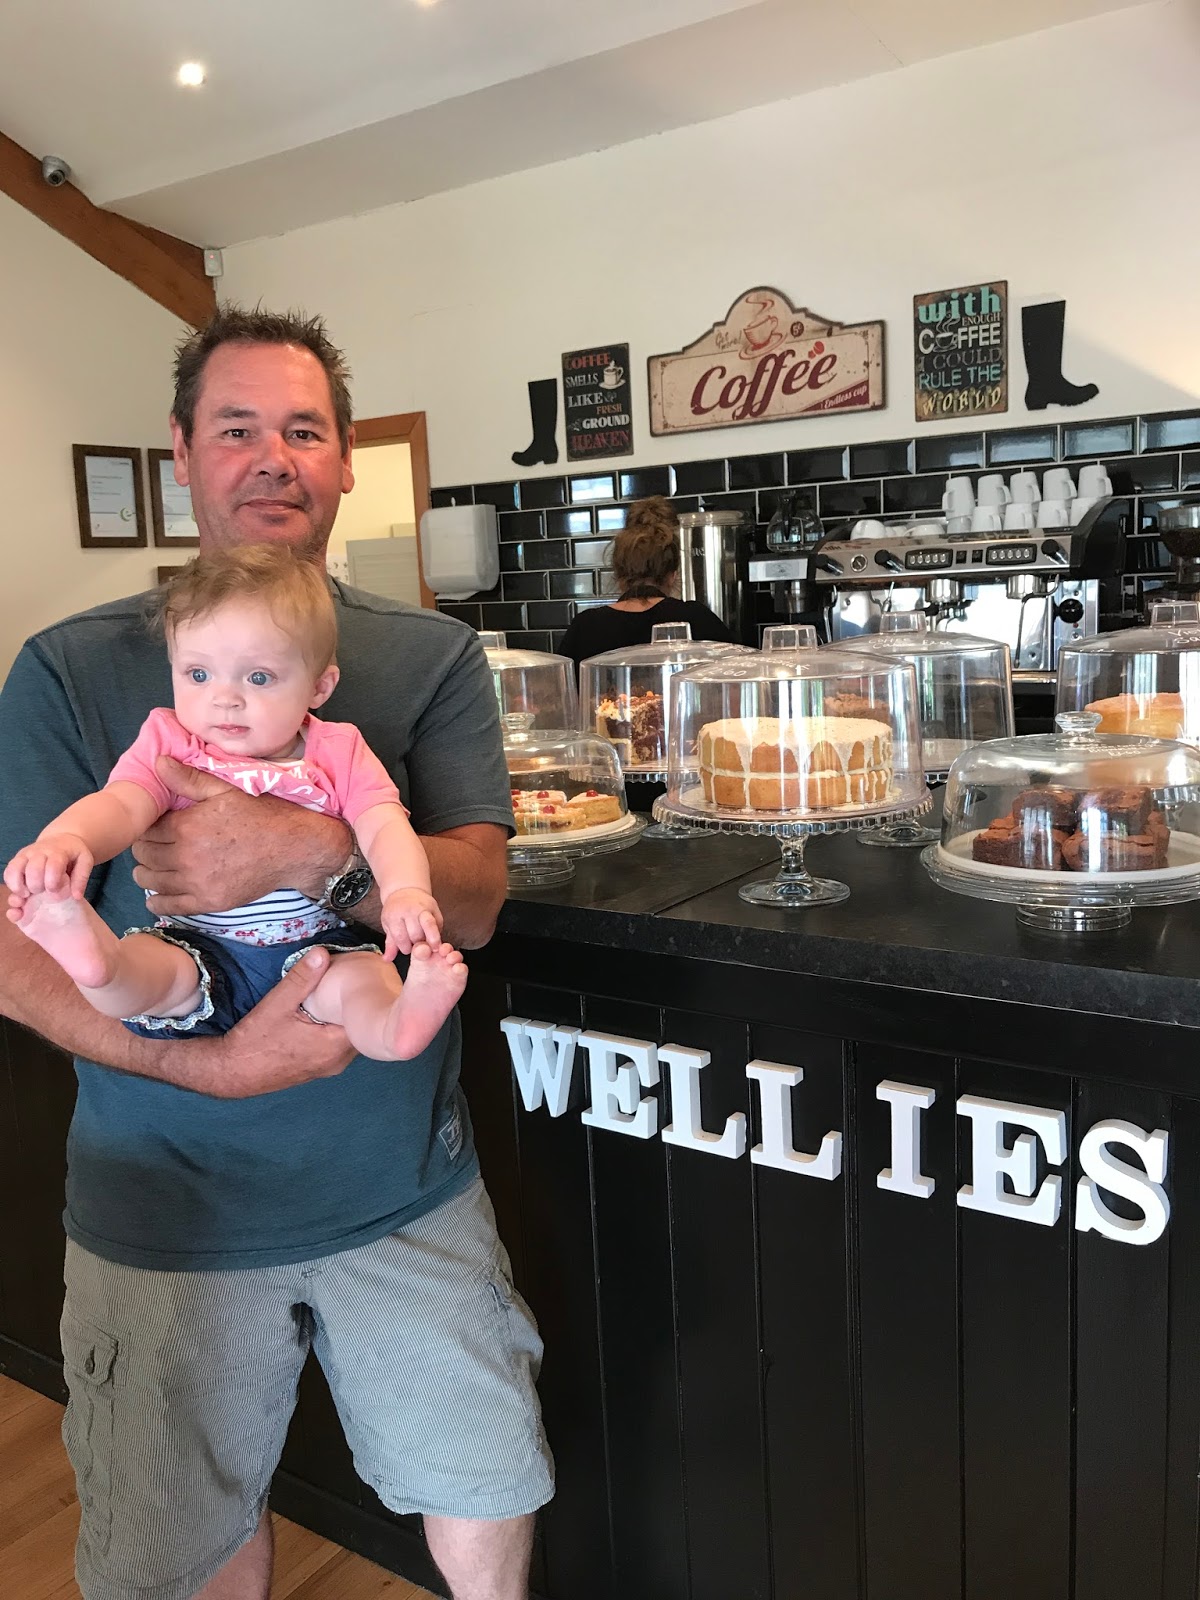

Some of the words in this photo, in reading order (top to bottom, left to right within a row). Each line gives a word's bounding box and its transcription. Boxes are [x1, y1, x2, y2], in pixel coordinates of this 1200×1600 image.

[918, 286, 1001, 323] with
[961, 312, 1001, 326] ENOUGH
[564, 352, 611, 370] COFFEE
[932, 347, 1002, 368] COULD
[565, 372, 599, 388] SMELLS
[690, 349, 838, 421] Coffee
[919, 368, 962, 390] RULE
[967, 363, 1001, 384] THE
[567, 391, 604, 408] LIKE
[596, 403, 622, 415] FRESH
[922, 386, 1001, 416] WORLD
[582, 414, 630, 429] GROUND
[571, 430, 630, 451] HEAVEN
[500, 1016, 1170, 1246] WELLIES
